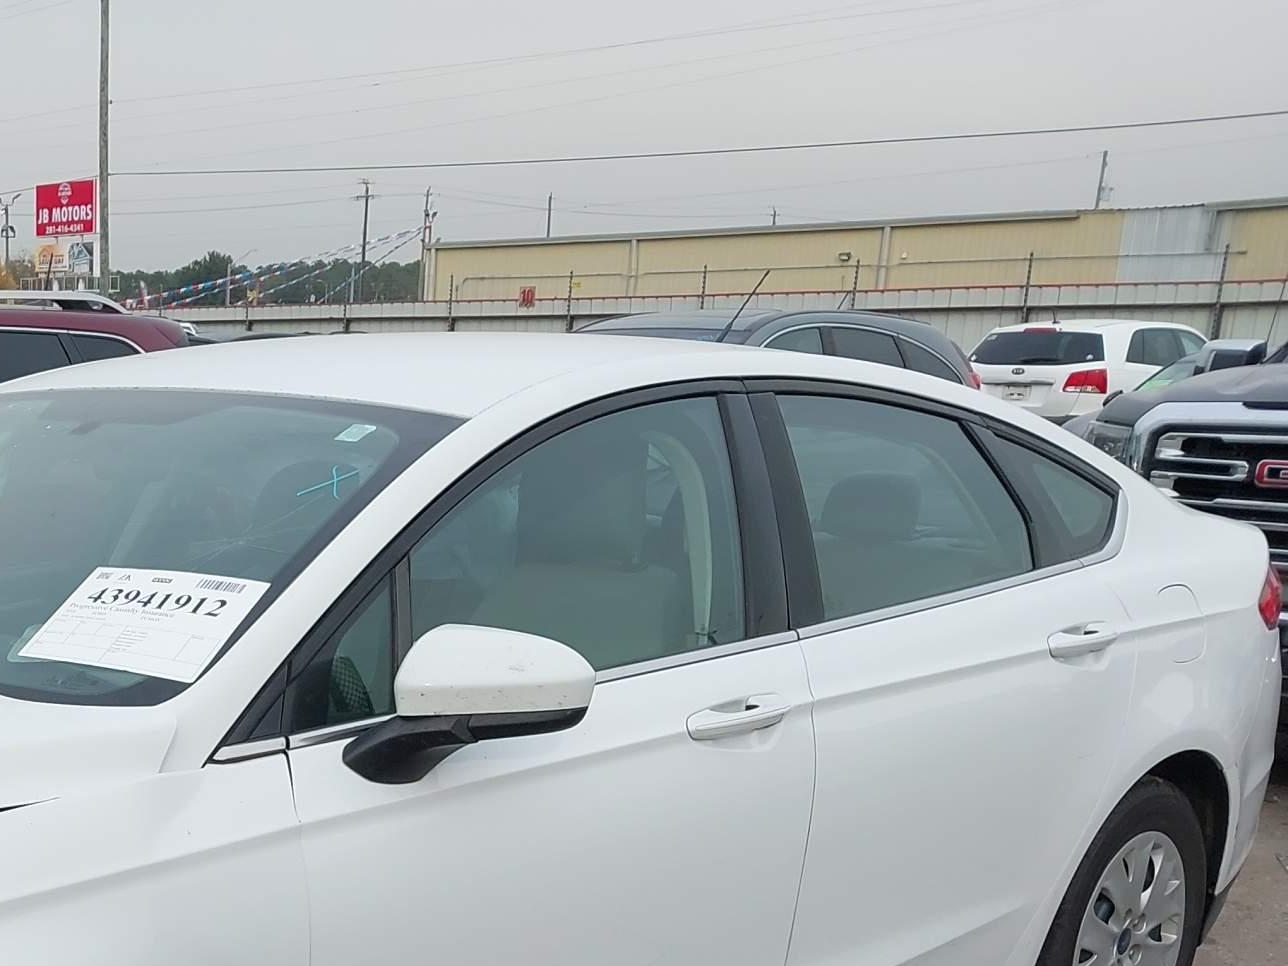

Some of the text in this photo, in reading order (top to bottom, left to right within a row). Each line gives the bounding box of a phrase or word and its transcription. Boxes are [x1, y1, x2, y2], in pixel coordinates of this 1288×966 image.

[38, 204, 93, 224] JB MOTORS
[88, 587, 228, 617] 43941912
